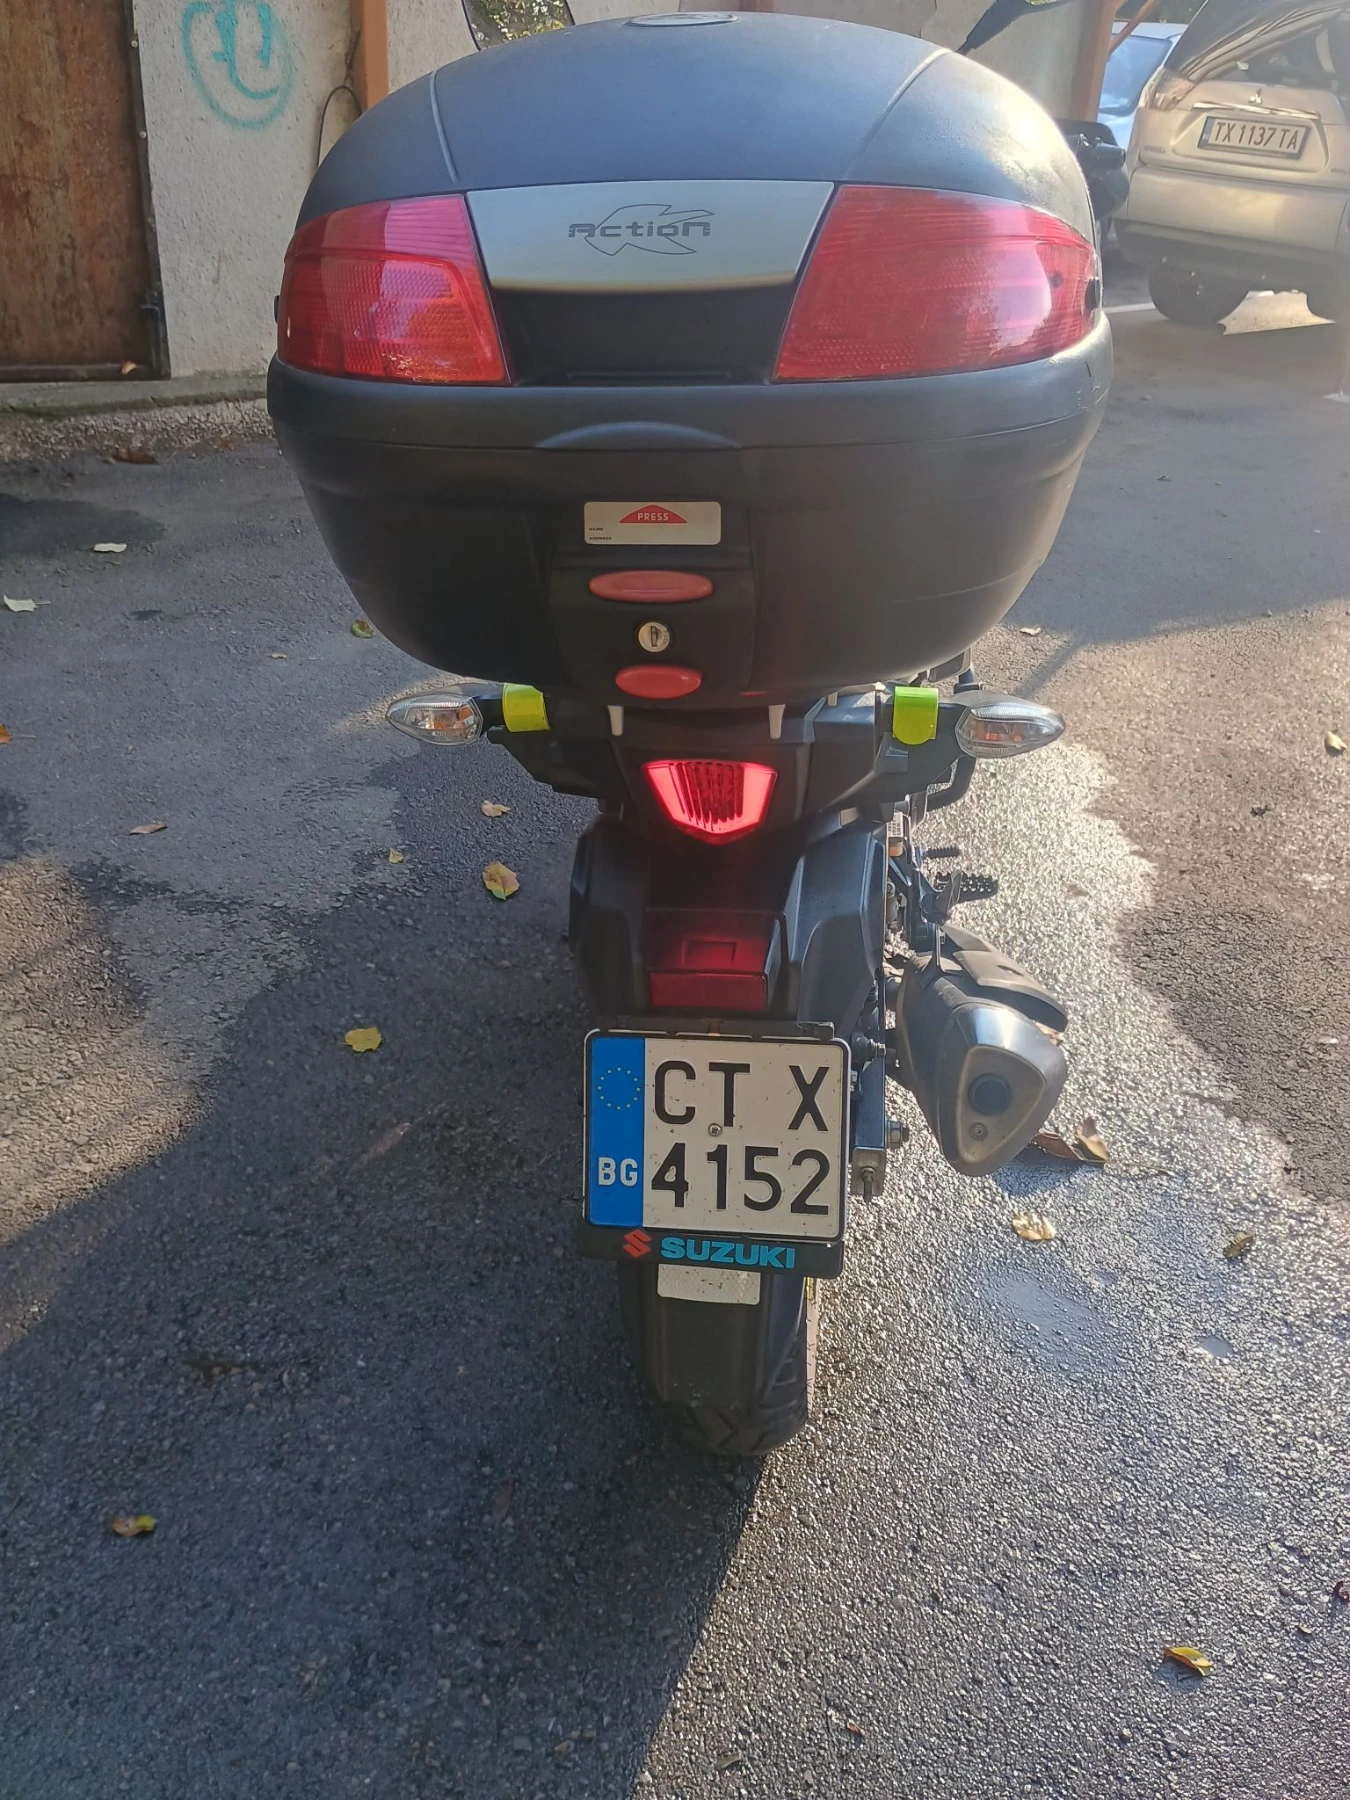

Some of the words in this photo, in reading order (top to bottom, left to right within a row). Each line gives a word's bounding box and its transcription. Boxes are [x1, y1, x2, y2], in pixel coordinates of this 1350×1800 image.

[1214, 122, 1236, 143] TX
[1238, 124, 1277, 147] 1137
[1279, 128, 1299, 150] TA
[568, 221, 711, 238] Action
[637, 512, 669, 521] PRESS
[654, 1060, 751, 1127] CT
[787, 1065, 830, 1132] X
[597, 1156, 639, 1187] BG
[651, 1142, 831, 1215] 4152
[660, 1237, 796, 1269] SUZUKI
